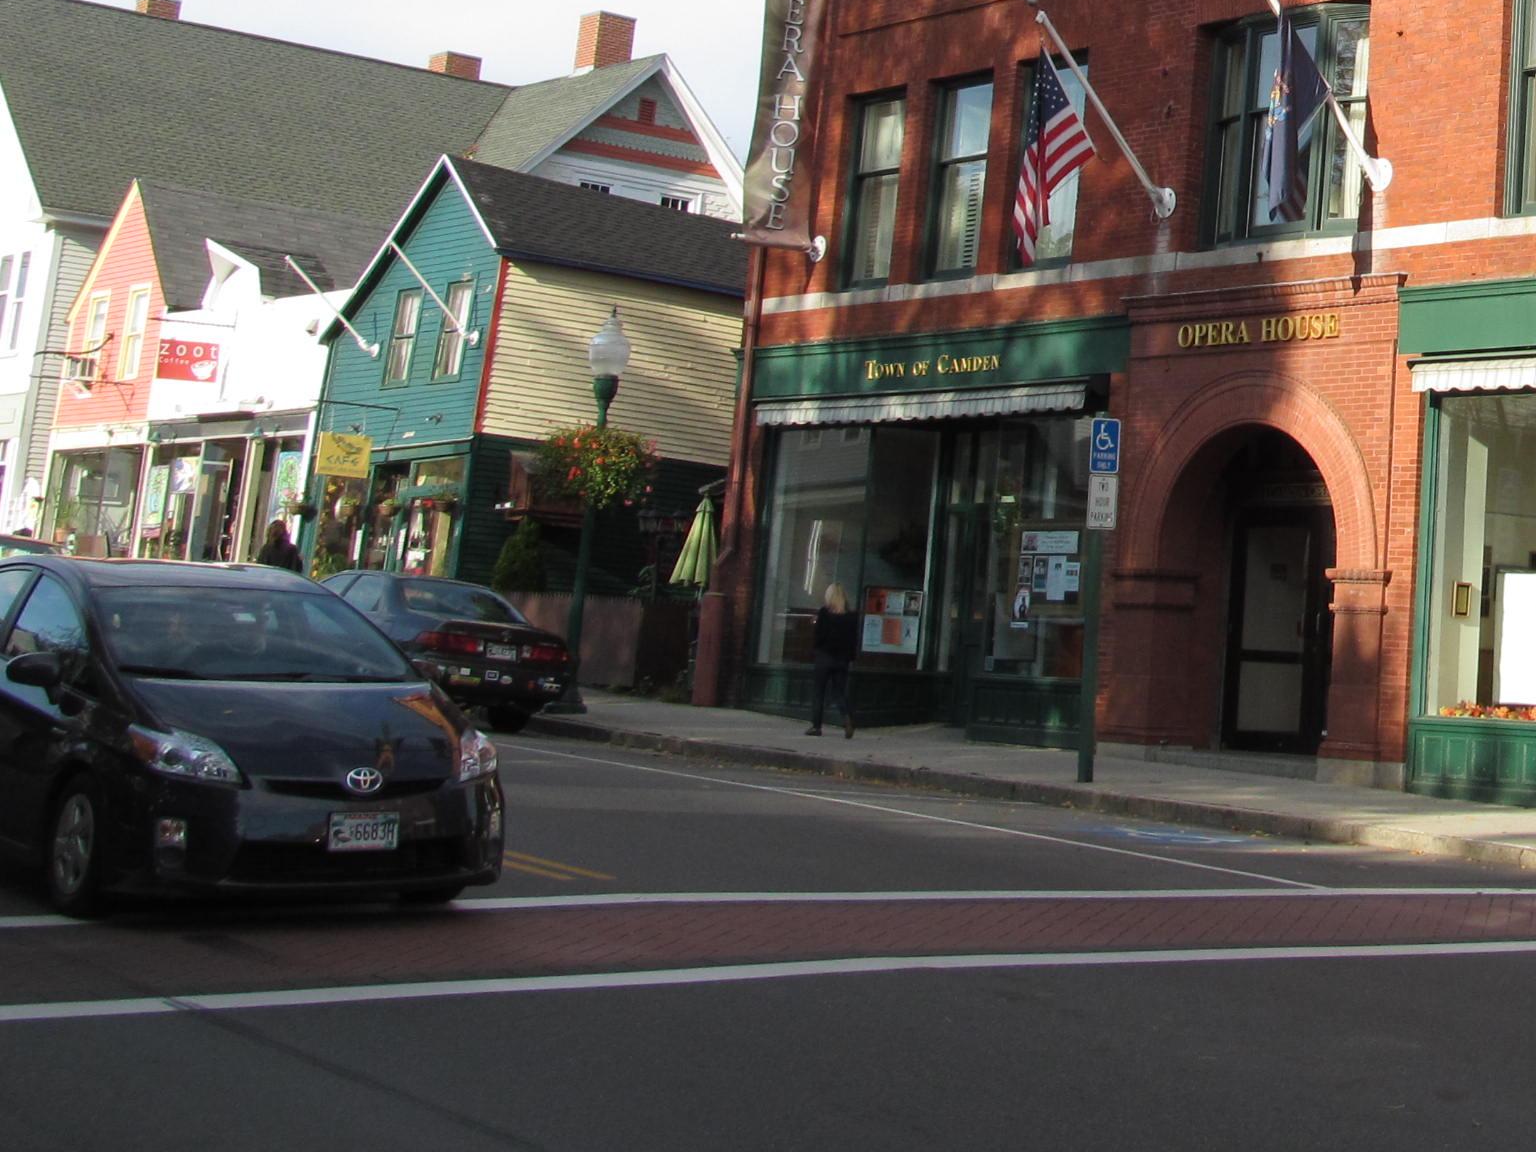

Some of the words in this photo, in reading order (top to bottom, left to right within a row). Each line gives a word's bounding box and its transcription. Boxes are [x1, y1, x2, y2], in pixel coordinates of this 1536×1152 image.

[765, 94, 801, 231] HOUSE
[1177, 320, 1251, 348] OPERA
[1261, 312, 1340, 342] HOUSE
[864, 359, 906, 380] TOWN
[937, 353, 1000, 375] CAMDEN
